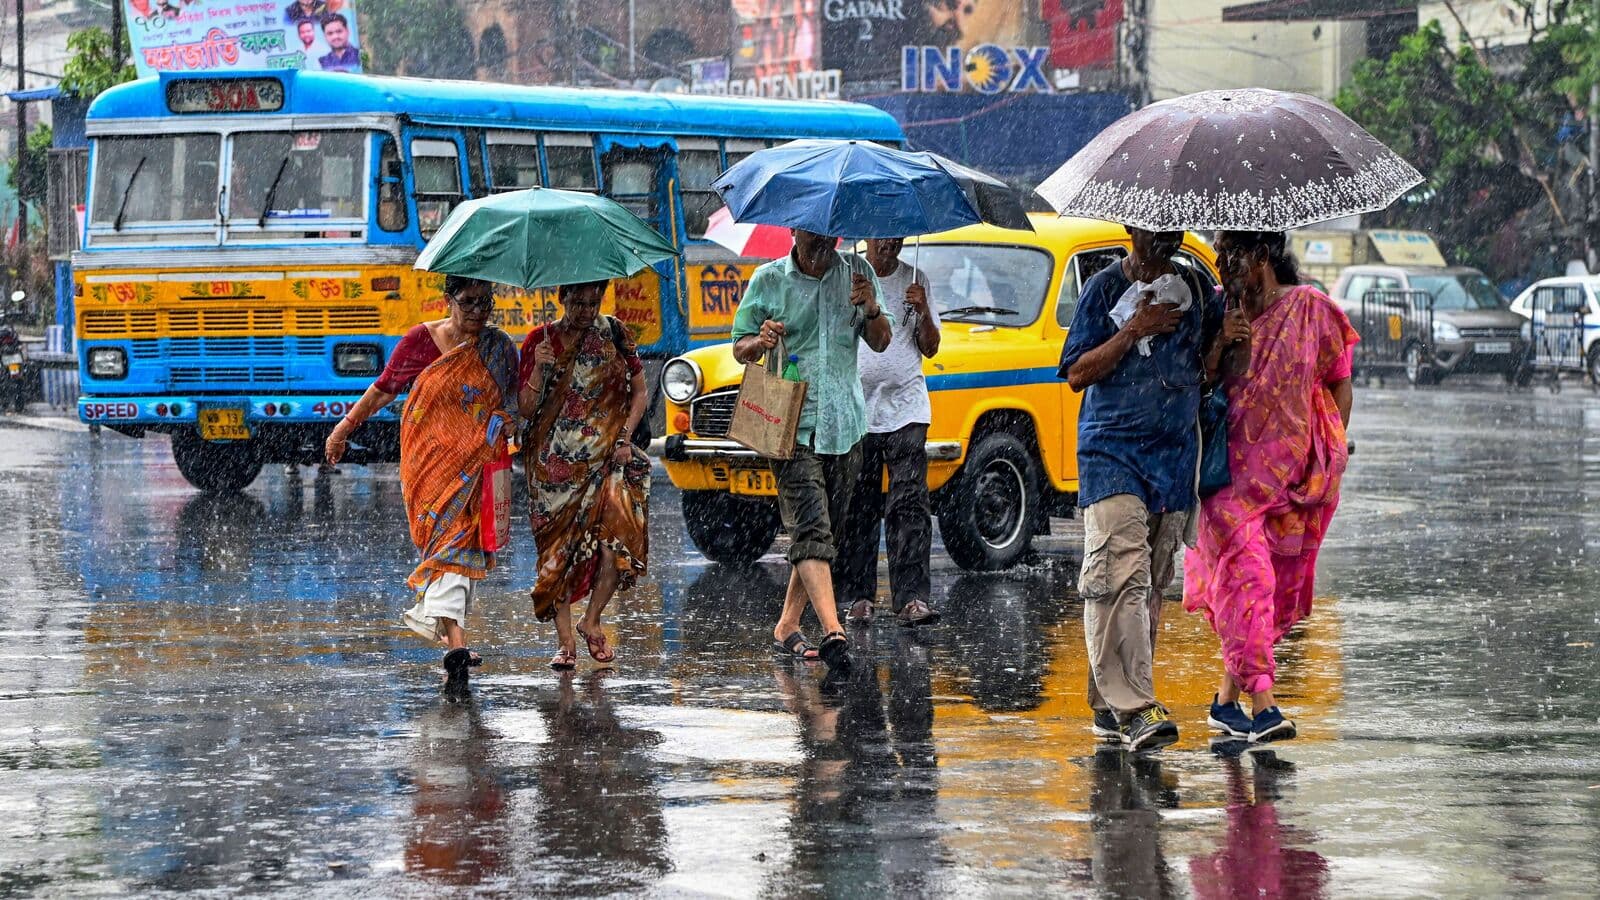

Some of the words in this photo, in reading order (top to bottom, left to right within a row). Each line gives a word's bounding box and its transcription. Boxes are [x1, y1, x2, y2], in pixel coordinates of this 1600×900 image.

[824, 0, 905, 21] GADAR
[859, 19, 873, 40] 2
[140, 27, 239, 70] মহাজাতি
[901, 43, 1054, 95] INOX
[84, 402, 138, 419] SPEED
